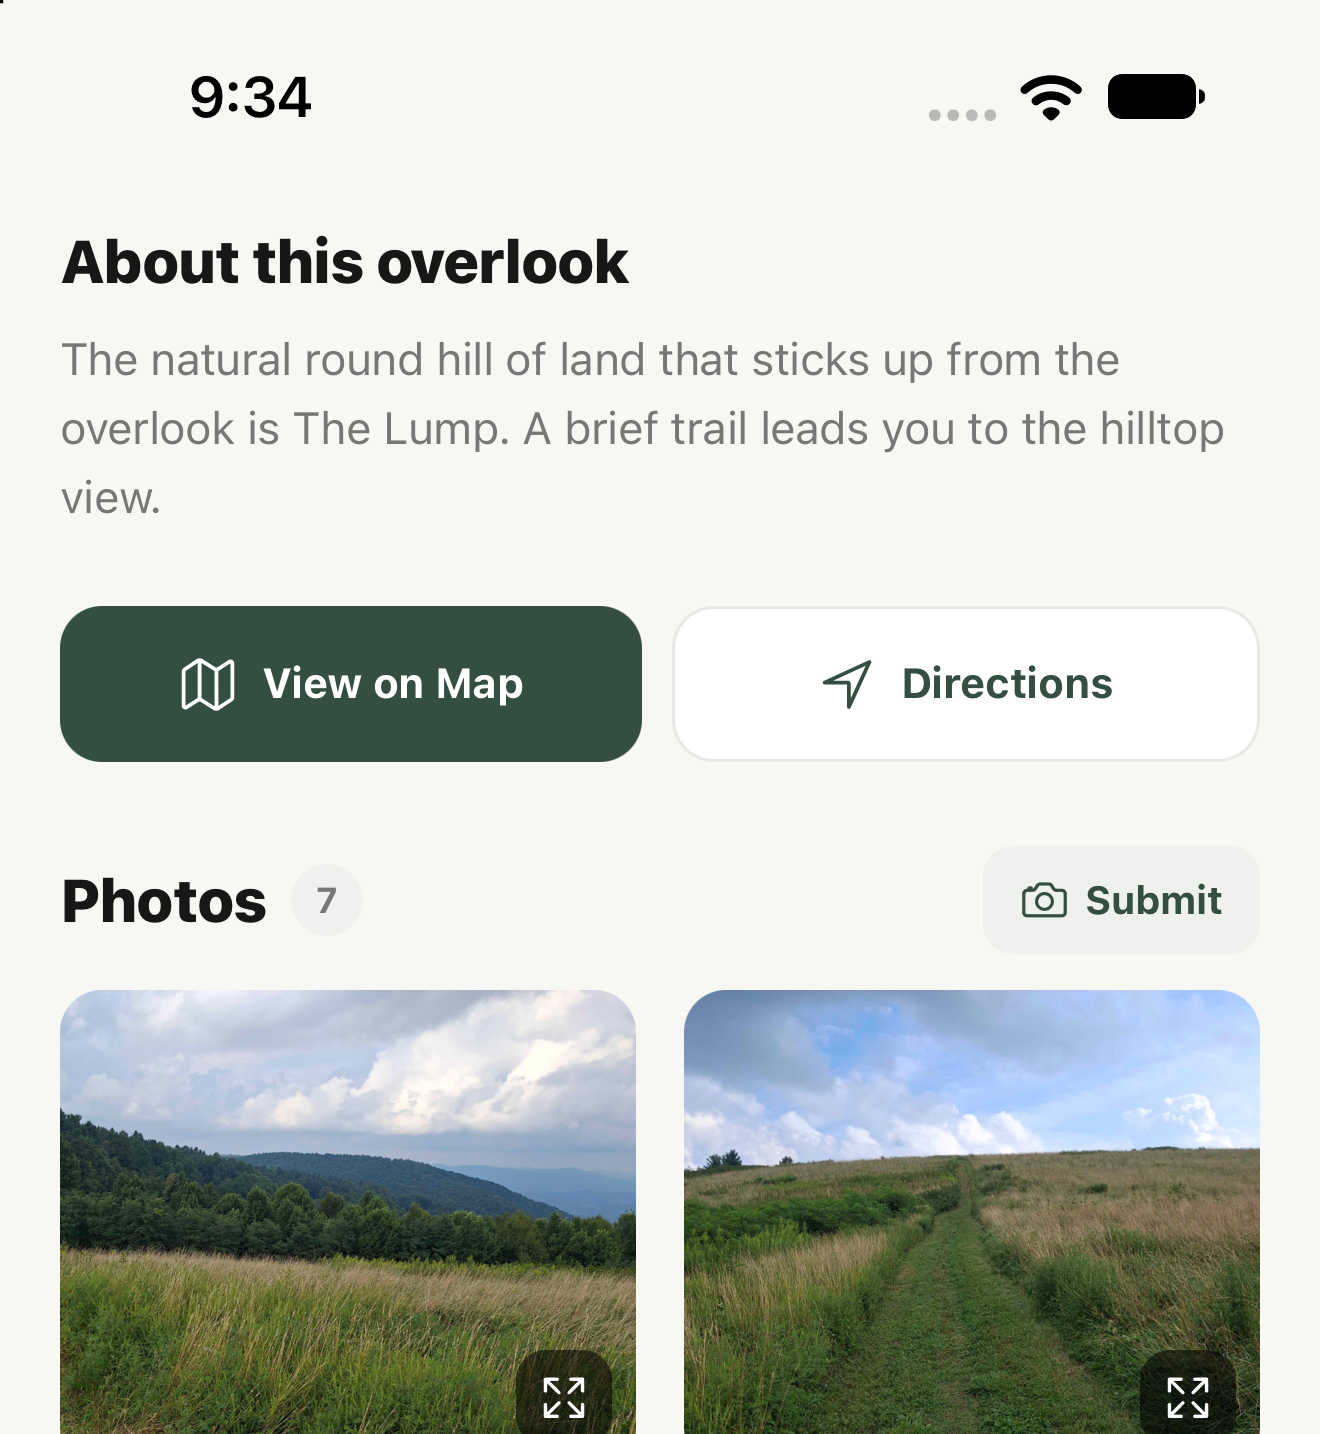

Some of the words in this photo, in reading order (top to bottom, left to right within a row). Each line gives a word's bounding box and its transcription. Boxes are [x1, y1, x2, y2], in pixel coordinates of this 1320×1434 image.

[190, 75, 311, 118] 9:34
[62, 238, 238, 284] About
[253, 235, 363, 284] this
[378, 238, 629, 284] overlook
[62, 342, 137, 376] The
[153, 342, 289, 376] natural
[307, 342, 421, 376] round
[440, 341, 491, 375] hill
[507, 342, 546, 376] of
[563, 342, 643, 376] land
[659, 342, 737, 376] that
[753, 341, 868, 376] sticks
[885, 351, 932, 383] up
[947, 342, 1039, 376] from
[1055, 342, 1119, 376] the
[62, 411, 234, 445] overlook
[250, 410, 278, 445] is
[294, 411, 370, 445] The
[387, 412, 508, 452] Lump.
[524, 412, 551, 444] A
[568, 410, 658, 445] brief
[671, 410, 745, 445] trail
[764, 411, 867, 445] leads
[883, 420, 953, 452] you
[968, 414, 1007, 445] to
[1022, 411, 1086, 445] the
[1103, 410, 1223, 452] hilltop
[62, 479, 159, 514] view.
[263, 665, 361, 699] View
[375, 675, 422, 699] on
[438, 668, 523, 706] Map
[904, 665, 1112, 699] Directions
[64, 877, 266, 923] Photos
[317, 886, 337, 913] 7
[1086, 883, 1222, 915] Submit
